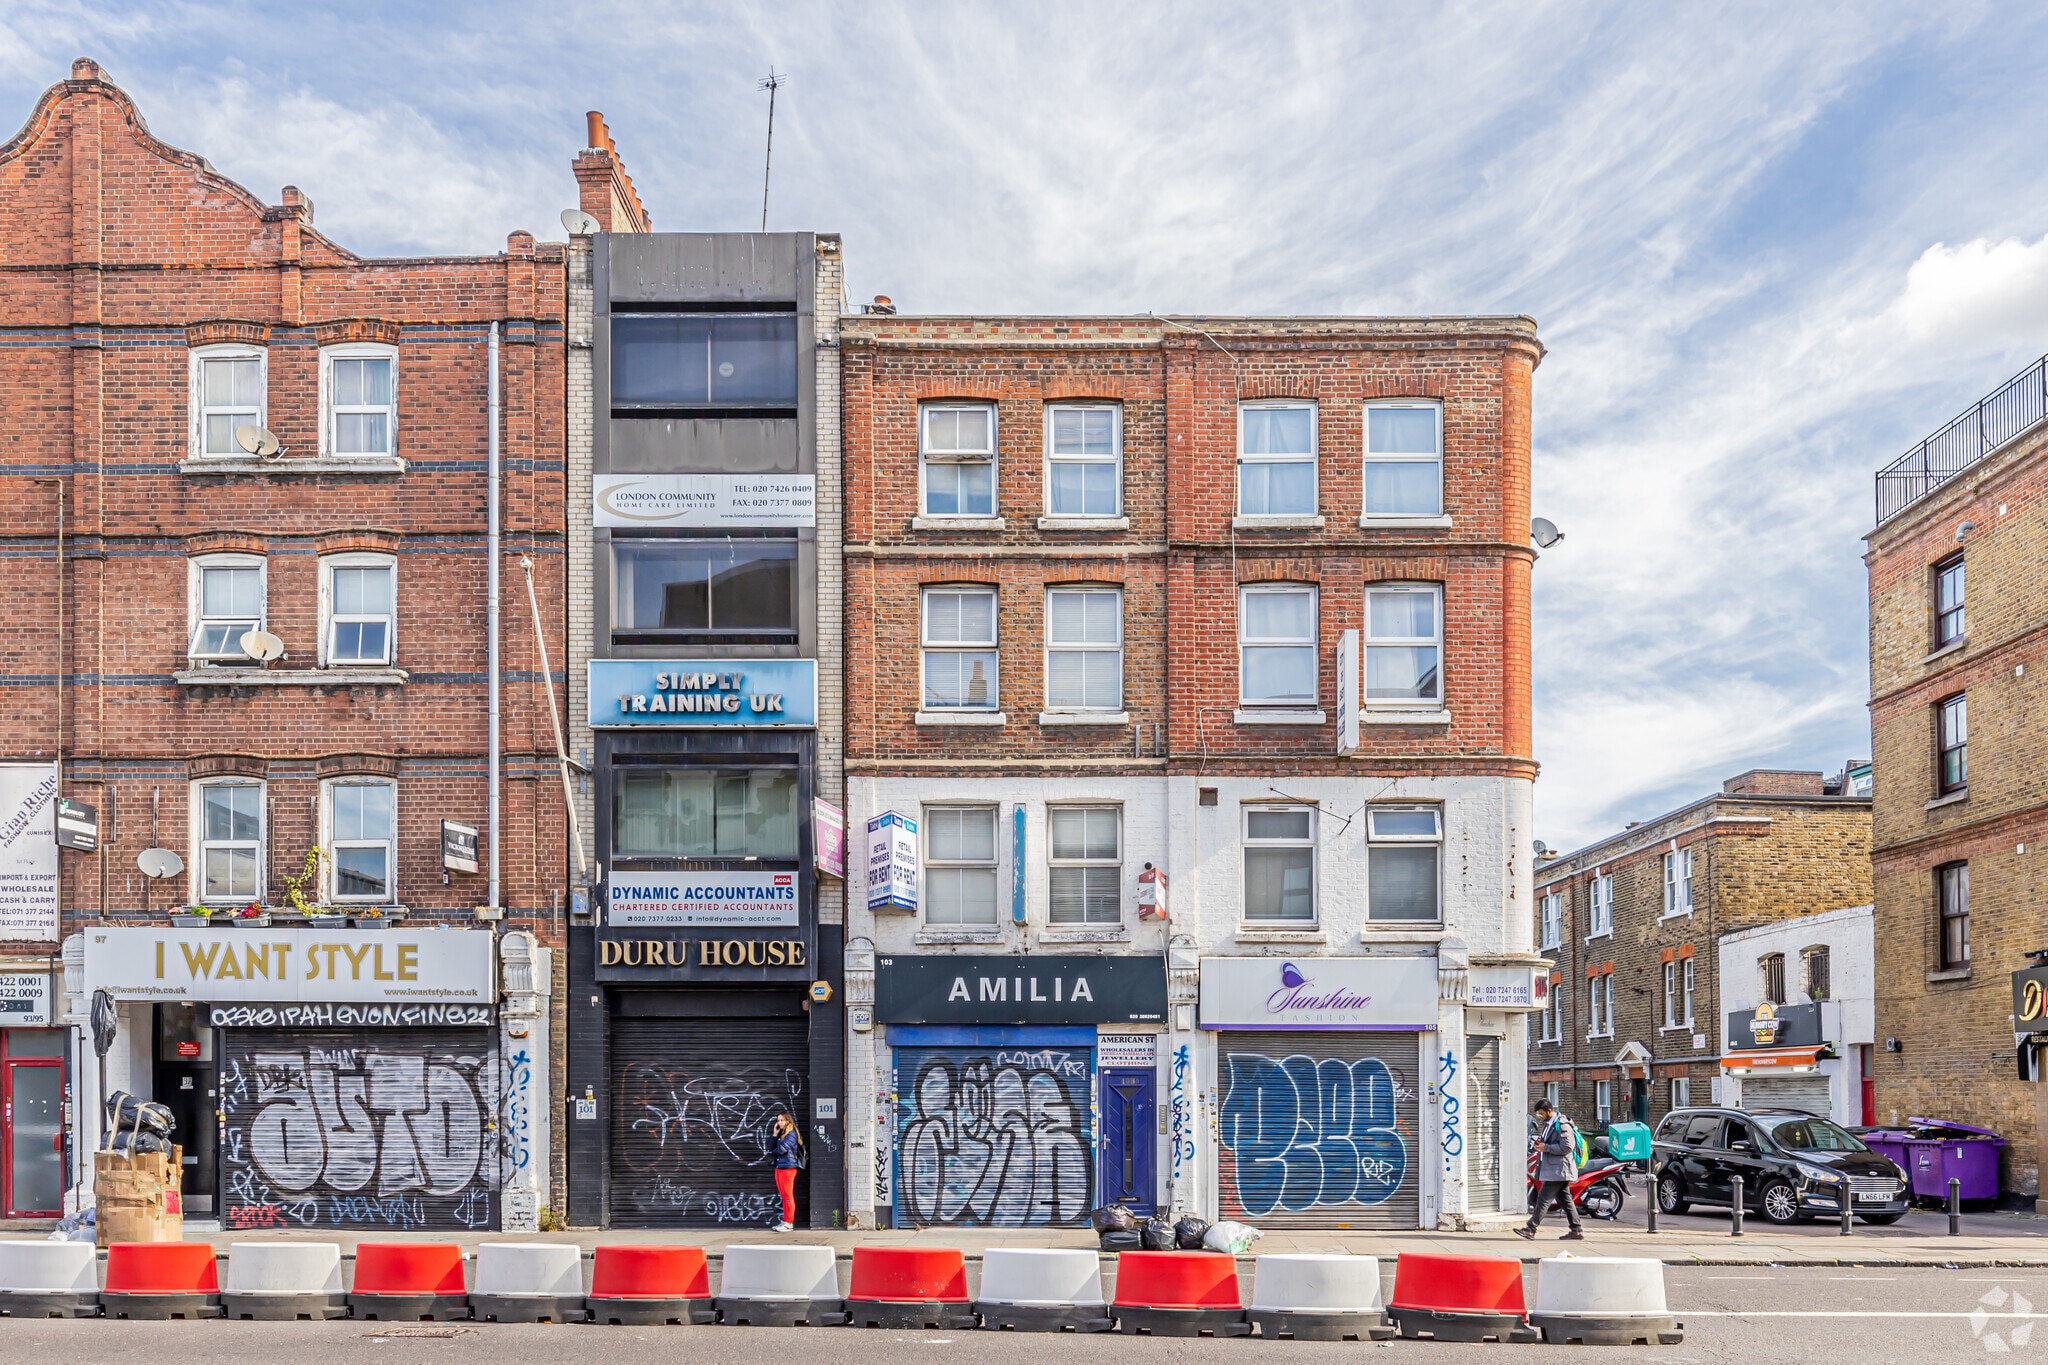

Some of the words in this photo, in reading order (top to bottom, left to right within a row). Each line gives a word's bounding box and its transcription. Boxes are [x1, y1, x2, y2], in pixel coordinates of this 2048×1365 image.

[734, 485, 751, 493] TEL:
[752, 485, 768, 493] 020
[769, 485, 790, 493] 7426
[791, 485, 812, 493] 0409
[616, 493, 656, 501] LONDON
[658, 493, 716, 501] COMMUNITY
[732, 499, 751, 507] FAX:
[752, 499, 768, 507] 020
[769, 499, 790, 507] 7377
[791, 499, 812, 507] 0809
[656, 672, 744, 690] SIMPLY
[618, 694, 741, 713] TRAINING
[749, 694, 784, 713] UK
[23, 775, 57, 810] Riche
[3, 818, 29, 849] FASHION
[874, 842, 886, 853] RETAIL
[898, 841, 912, 853] RETAIL
[870, 852, 890, 866] PREMISES
[896, 851, 914, 866] PREMISES
[869, 868, 878, 886] FOR
[879, 864, 890, 884] RENT
[894, 864, 902, 882] FOR
[904, 868, 915, 886] RENT
[612, 886, 679, 900] DYNAMIC
[684, 886, 794, 900] ACCOUNTANTS
[612, 903, 668, 911] CHARTERED
[672, 903, 720, 911] CERTIFIED
[723, 903, 794, 911] ACCOUNTANTS
[94, 936, 107, 944] 97
[600, 940, 689, 966] DURU
[698, 940, 806, 966] HOUSE
[155, 941, 165, 979] I
[178, 941, 293, 981] WANT
[305, 942, 418, 982] STYLE
[18, 978, 41, 986] 0001
[948, 976, 1094, 1002] AMILIA
[18, 988, 42, 998] 0009
[384, 988, 478, 997] www.iwantstyle.co.uk
[1266, 982, 1372, 1014] Sunshine
[2019, 980, 2048, 1022] D
[818, 1104, 834, 1113] 101
